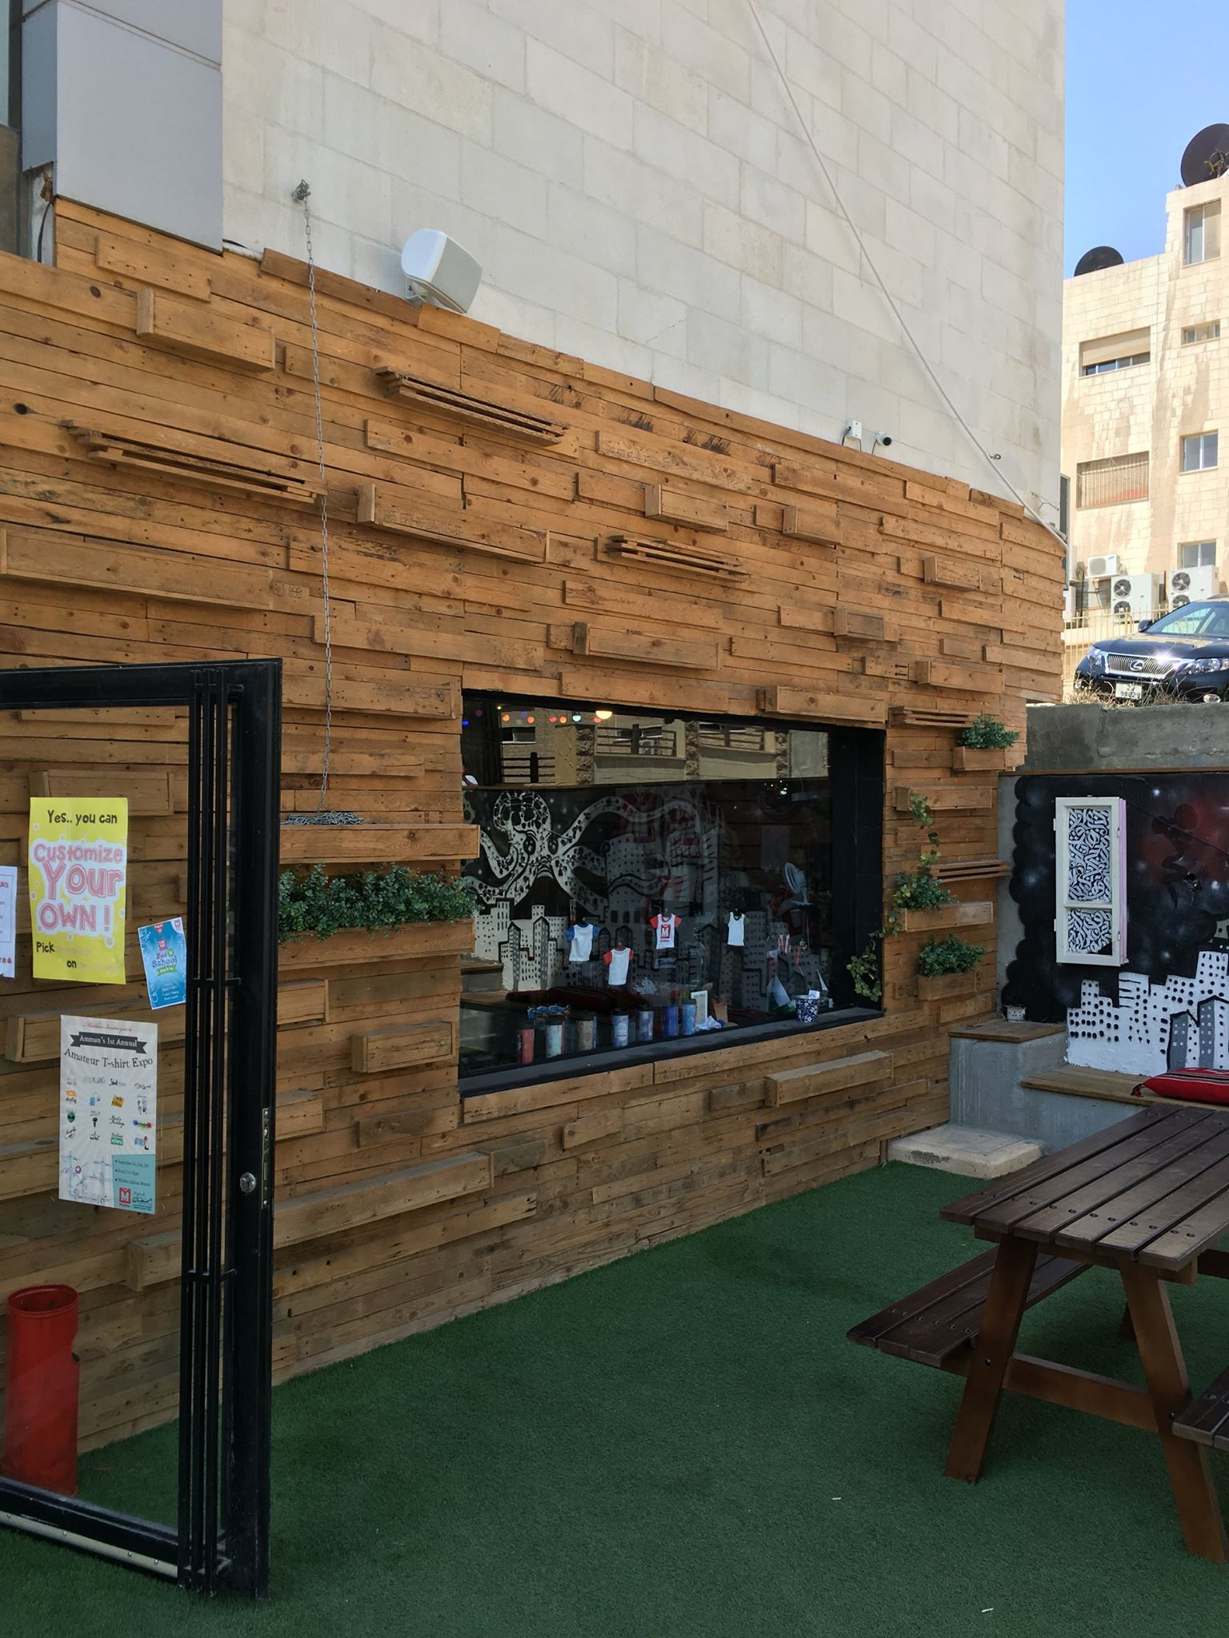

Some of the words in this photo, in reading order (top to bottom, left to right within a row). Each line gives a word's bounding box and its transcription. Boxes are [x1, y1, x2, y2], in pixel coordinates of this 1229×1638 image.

[47, 810, 73, 824] Yes..
[75, 813, 96, 826] you
[98, 814, 118, 824] can
[33, 843, 124, 864] Customize
[36, 941, 56, 953] Pick
[66, 959, 77, 969] on
[64, 1048, 100, 1066] Amateur
[101, 1056, 130, 1069] T-shirt
[131, 1057, 154, 1069] Expo
